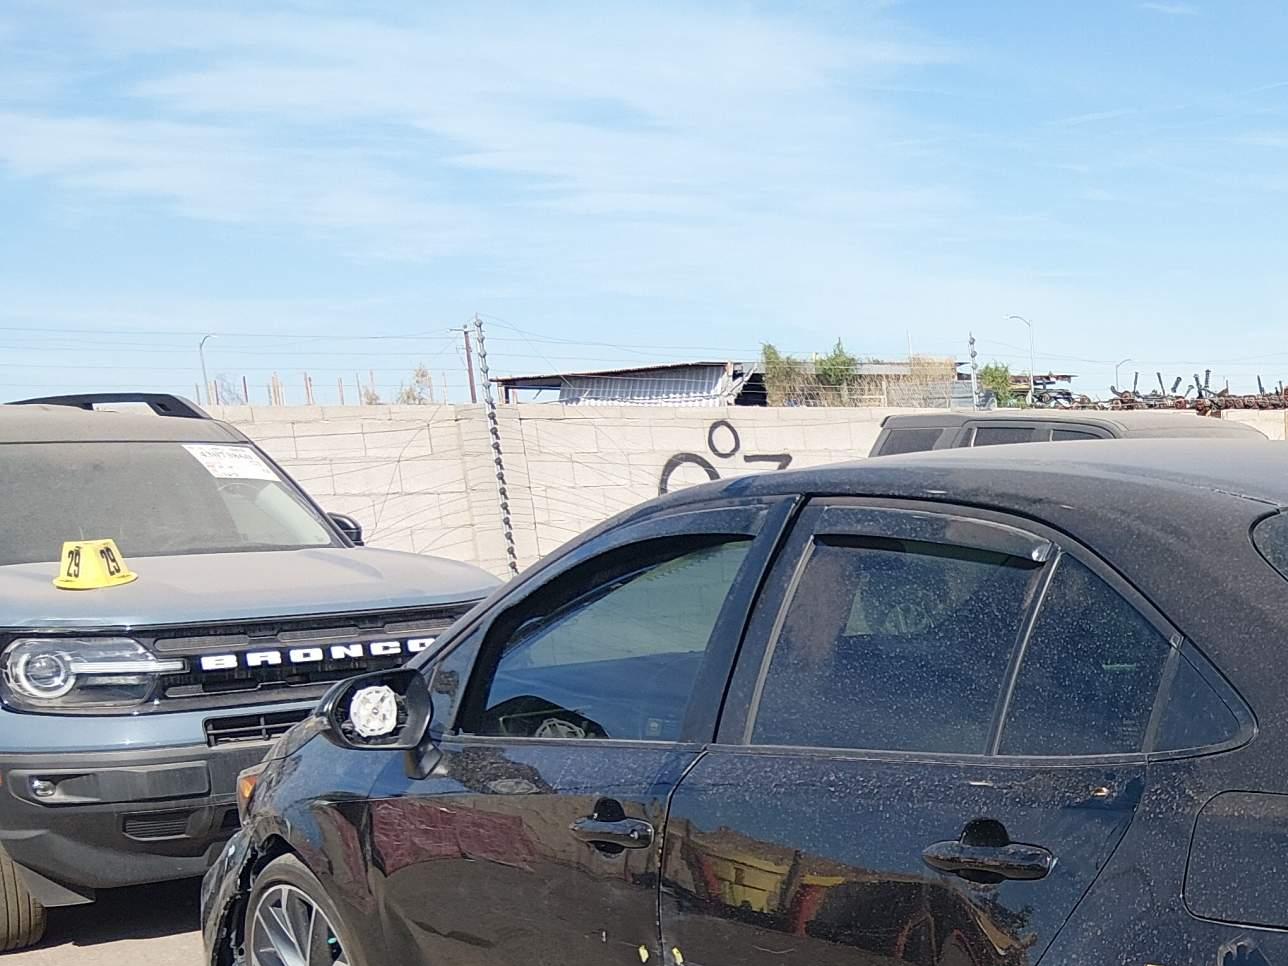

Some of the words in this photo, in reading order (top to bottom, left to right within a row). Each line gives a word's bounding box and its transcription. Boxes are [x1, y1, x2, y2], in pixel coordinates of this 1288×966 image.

[66, 547, 81, 578] 29
[100, 546, 121, 576] 29
[201, 637, 436, 671] BRONCO
